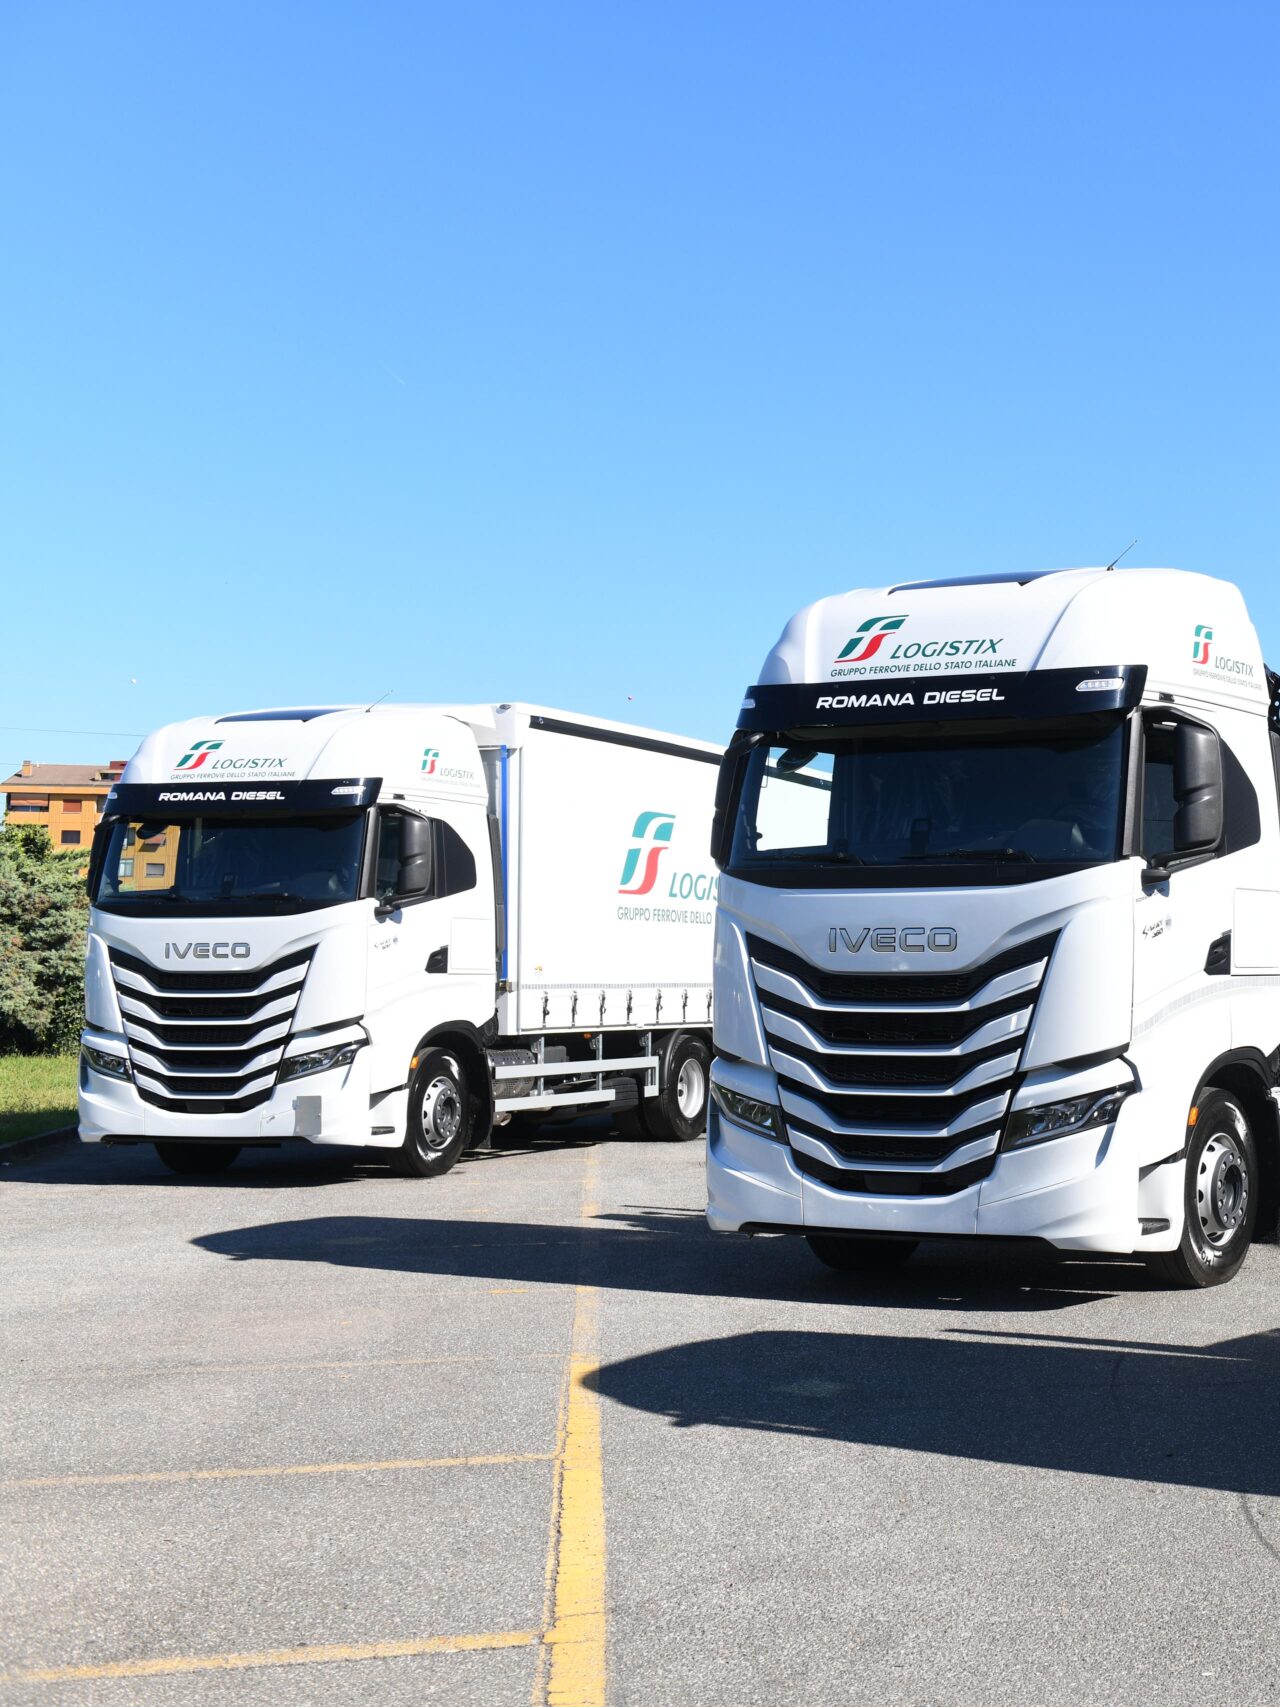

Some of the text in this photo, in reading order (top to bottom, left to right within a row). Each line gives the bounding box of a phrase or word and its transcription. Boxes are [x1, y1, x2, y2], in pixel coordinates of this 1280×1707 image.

[889, 638, 1004, 660] LOGISTIX
[830, 658, 1017, 678] GRUPPO FERROVIE DELLO STATO ITALIANE
[1215, 655, 1254, 677] LOGISTIX
[815, 688, 1005, 709] ROMANA DIESEL
[211, 757, 288, 770] LOGISTIX
[440, 767, 475, 780] LOGISTIX
[158, 791, 286, 802] ROMANA DIESEL
[617, 906, 712, 925] GRUPPO FERROVIE DELLO
[828, 926, 958, 954] IVECO
[164, 942, 251, 960] IVECO
